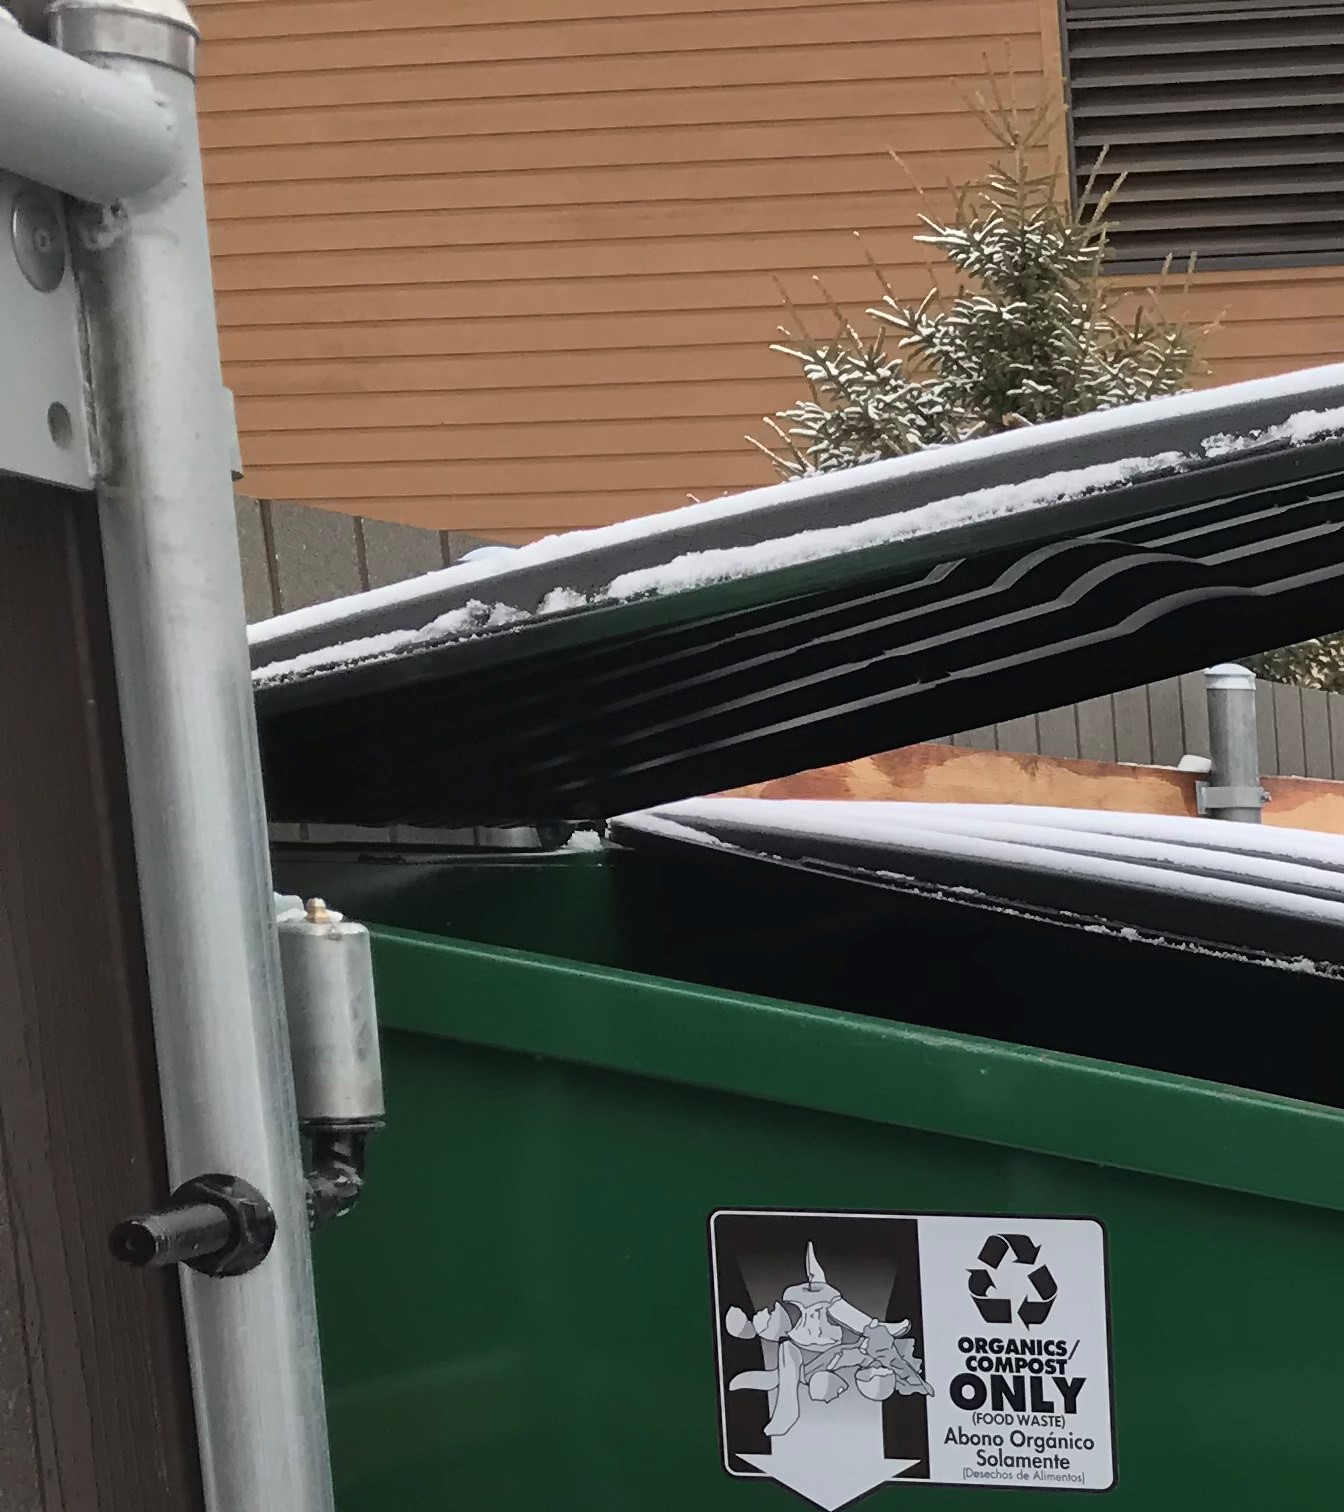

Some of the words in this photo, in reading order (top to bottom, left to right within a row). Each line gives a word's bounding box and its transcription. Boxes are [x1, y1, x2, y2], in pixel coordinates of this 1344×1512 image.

[957, 1336, 1080, 1360] ORGANICS/
[965, 1355, 1068, 1375] COMPOST
[949, 1372, 1087, 1415] ONLY
[972, 1411, 1015, 1426] (FOOD
[1016, 1414, 1066, 1429] WASTE)
[944, 1426, 1004, 1447] Abono
[1009, 1429, 1095, 1454] Orgánico
[976, 1448, 1071, 1470] Solamente
[962, 1467, 1013, 1481] (Desechos
[1016, 1469, 1029, 1481] de
[1032, 1470, 1085, 1485] Alimentos)
